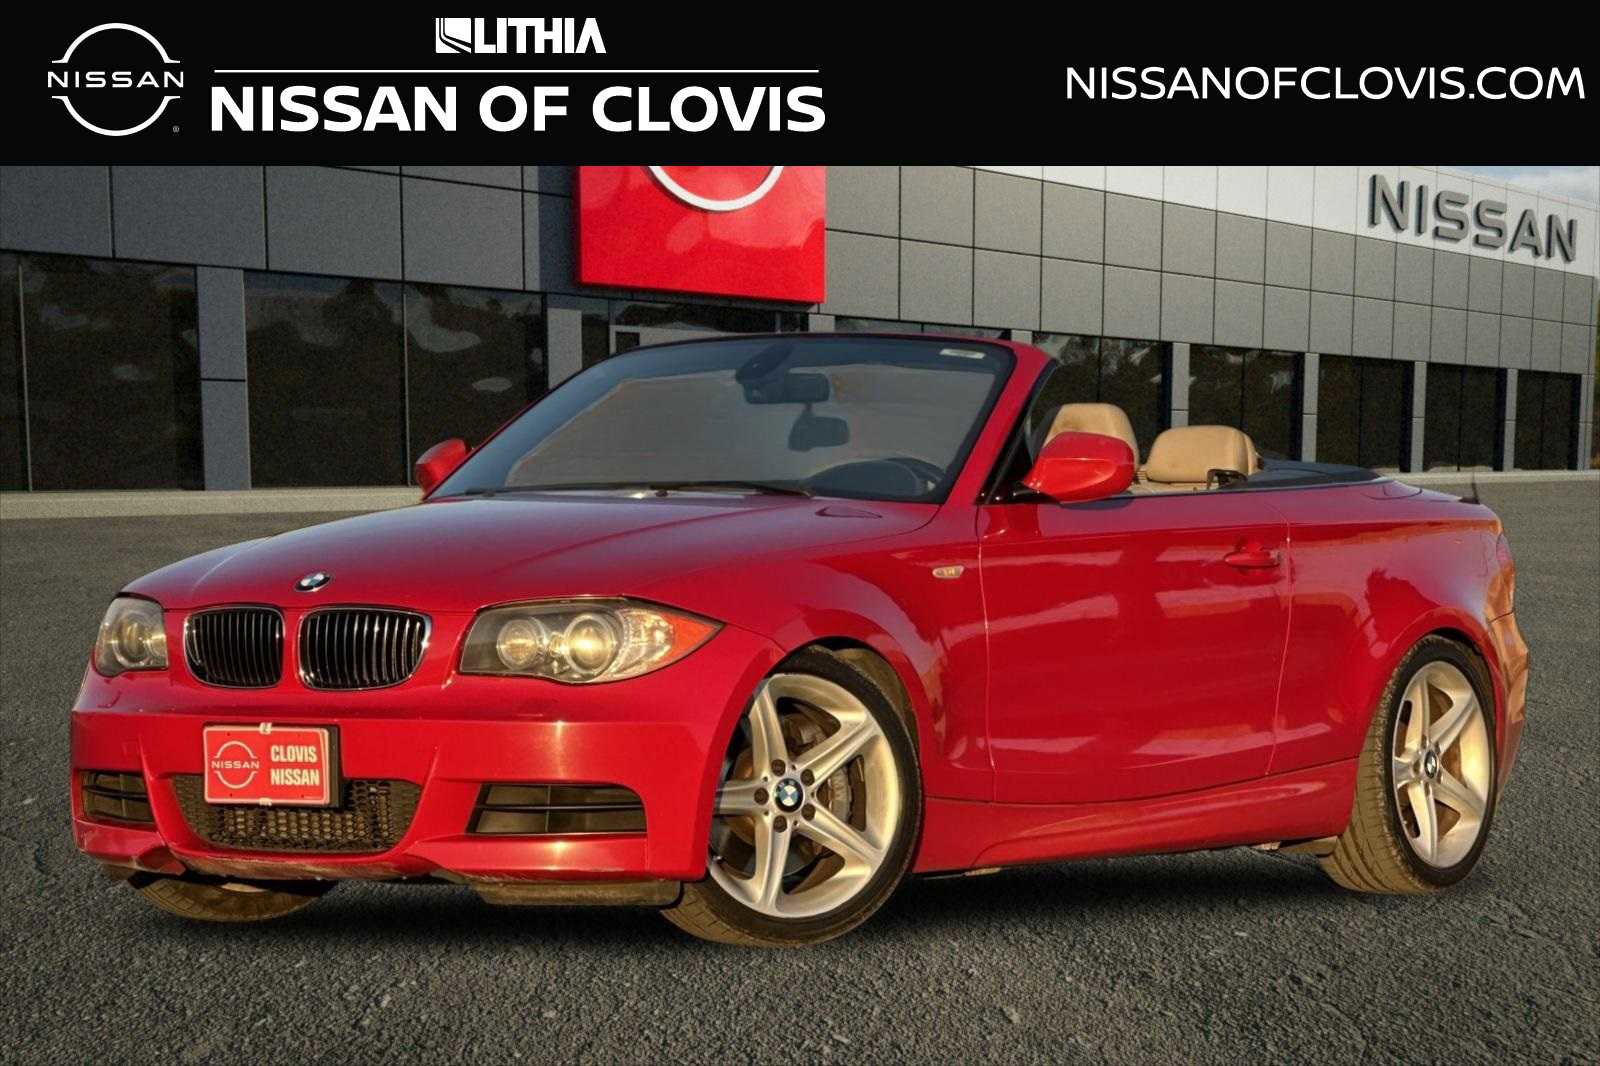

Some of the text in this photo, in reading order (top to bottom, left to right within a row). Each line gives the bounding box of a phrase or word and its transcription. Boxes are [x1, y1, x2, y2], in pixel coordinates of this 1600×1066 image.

[1368, 174, 1578, 263] NISSAN
[270, 745, 318, 763] CLOVIS
[211, 760, 260, 769] NISSAN
[270, 768, 320, 786] NISSAN
